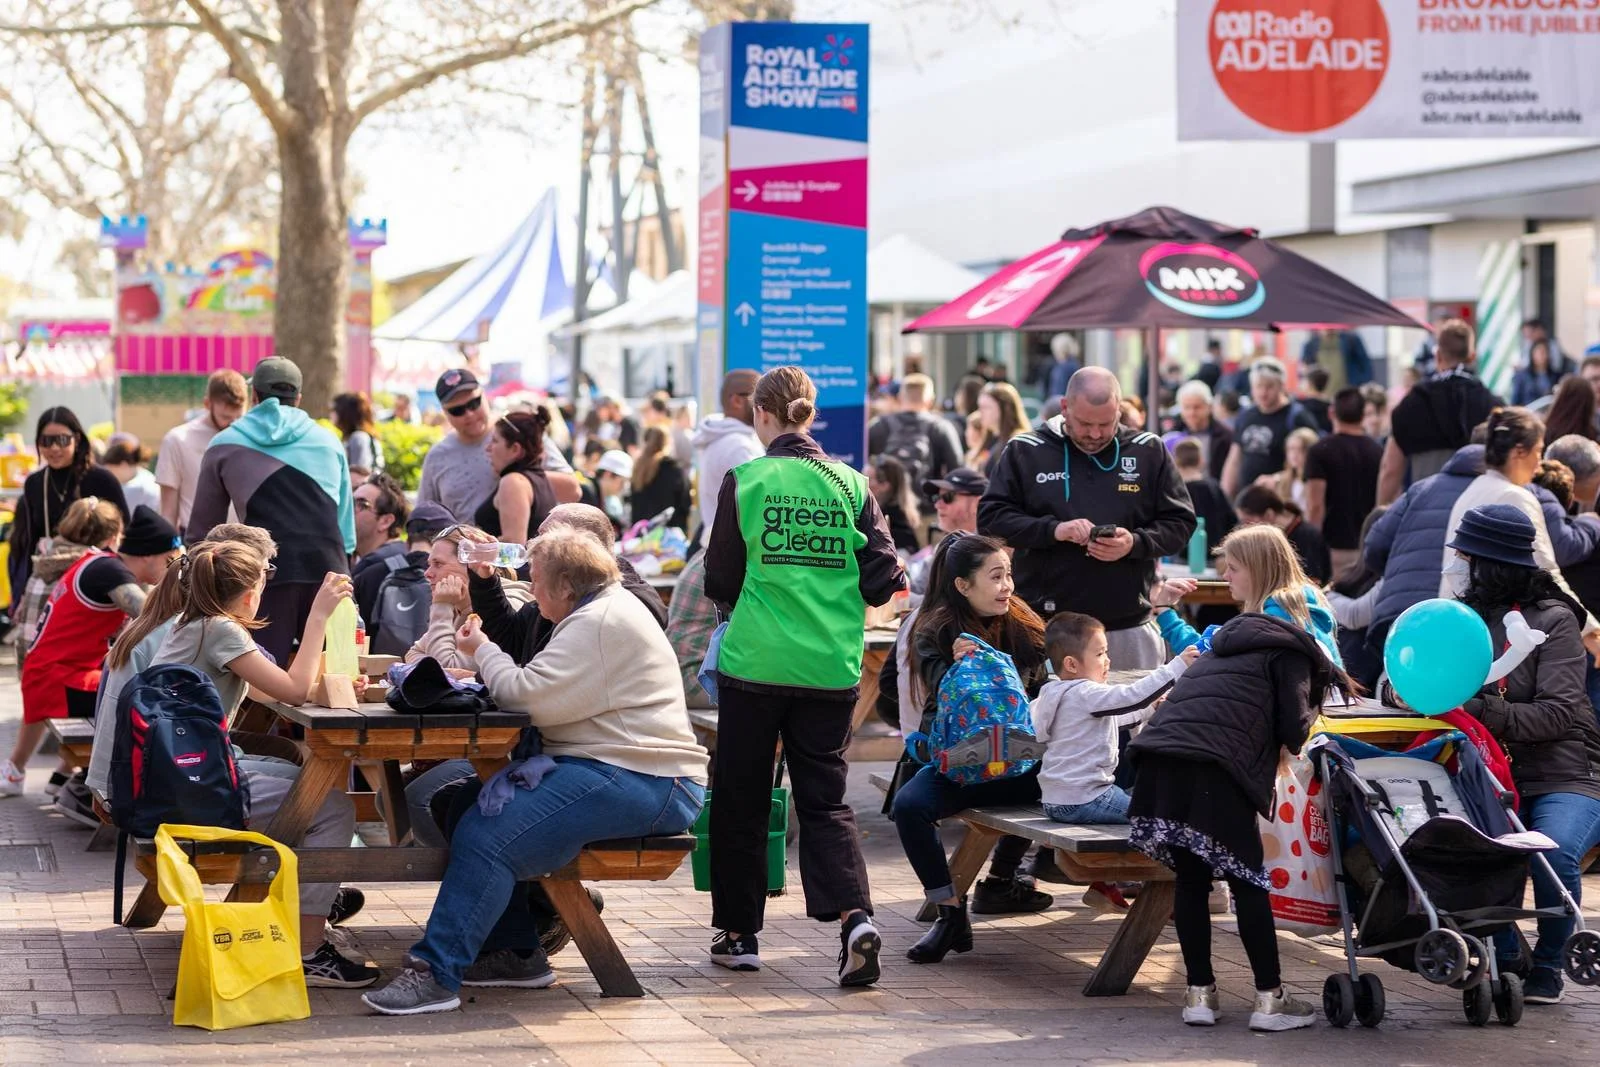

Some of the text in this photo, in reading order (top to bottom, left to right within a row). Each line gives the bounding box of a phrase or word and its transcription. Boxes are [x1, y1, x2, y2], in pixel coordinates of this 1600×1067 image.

[1254, 11, 1334, 38] Radio
[1419, 15, 1480, 32] FROM
[1488, 15, 1525, 32] THE
[1217, 39, 1383, 71] ADELAIDE
[743, 68, 857, 88] ADELAIDE
[746, 88, 818, 108] SHOW
[1422, 110, 1582, 124] abc.net.au/adelaide
[1159, 267, 1246, 290] MIX
[763, 506, 848, 530] green
[761, 528, 847, 555] Clean
[1310, 815, 1329, 828] BETT
[1310, 826, 1329, 844] BAG
